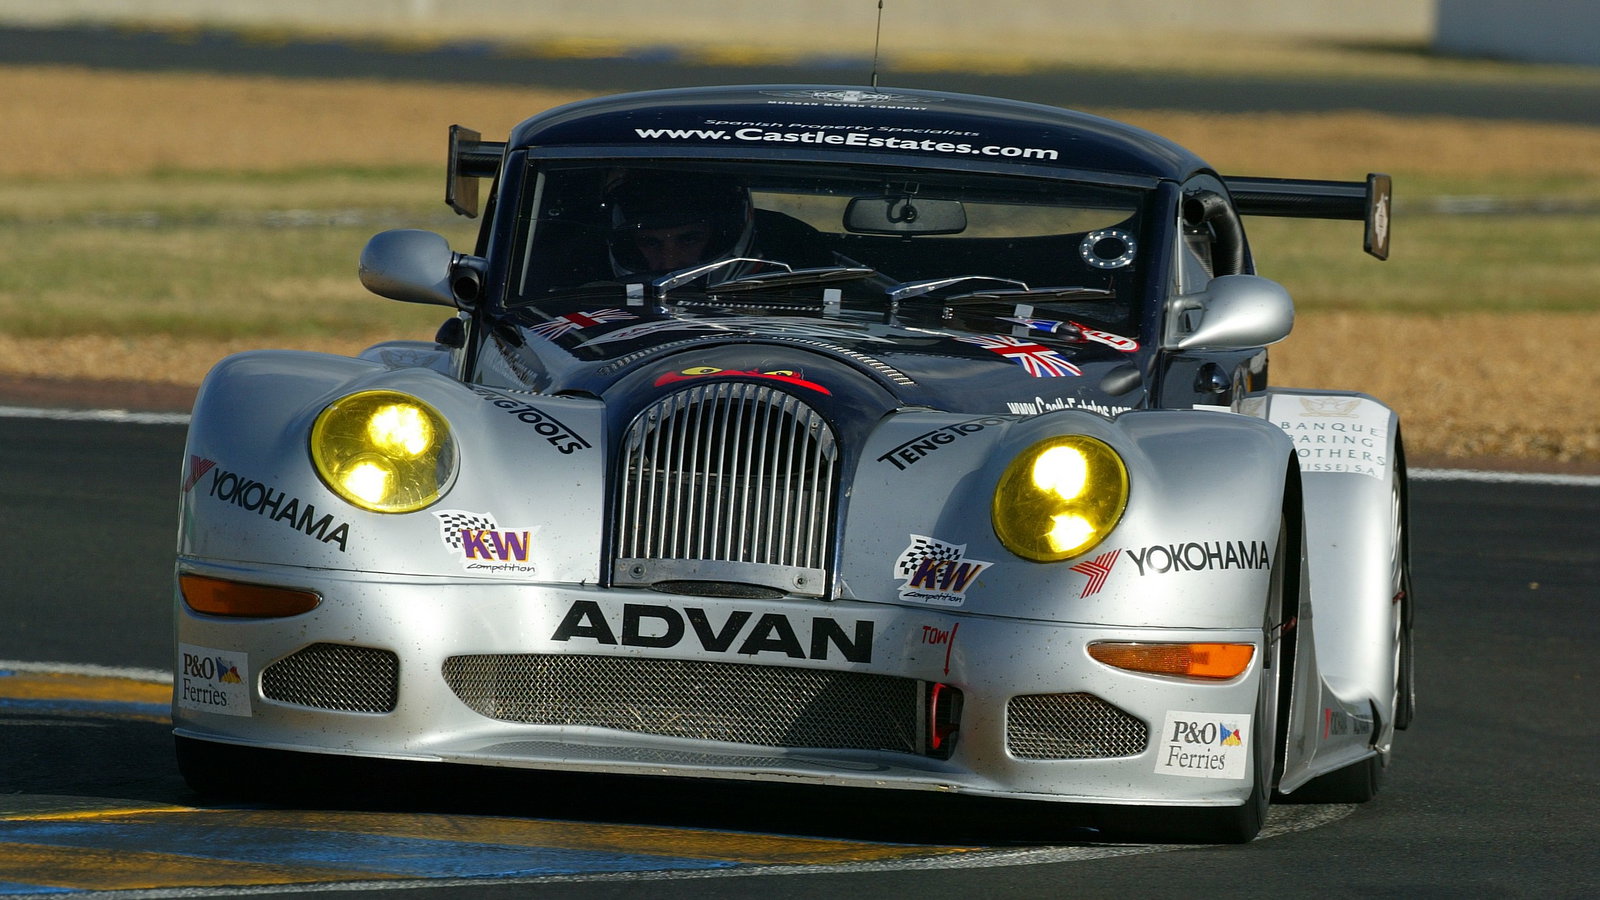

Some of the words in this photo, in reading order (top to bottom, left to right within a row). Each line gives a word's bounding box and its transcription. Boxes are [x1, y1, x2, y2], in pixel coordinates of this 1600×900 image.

[704, 119, 784, 129] Spanish
[788, 123, 874, 133] Property
[877, 126, 980, 137] Specialists
[634, 127, 1058, 160] www.CastleEstates.com
[1281, 421, 1385, 438] BANQUE
[1297, 448, 1385, 466] OTHERS
[209, 467, 350, 553] YOKOHAMA
[460, 529, 531, 562] KW
[1126, 540, 1270, 576] YOKOHAMA
[909, 556, 982, 593] KW
[550, 600, 874, 663] ADVAN
[922, 625, 949, 645] TOW
[183, 653, 215, 680] P&O
[183, 678, 228, 707] Ferries
[1170, 721, 1217, 745] P&O
[1165, 745, 1226, 770] Ferries
